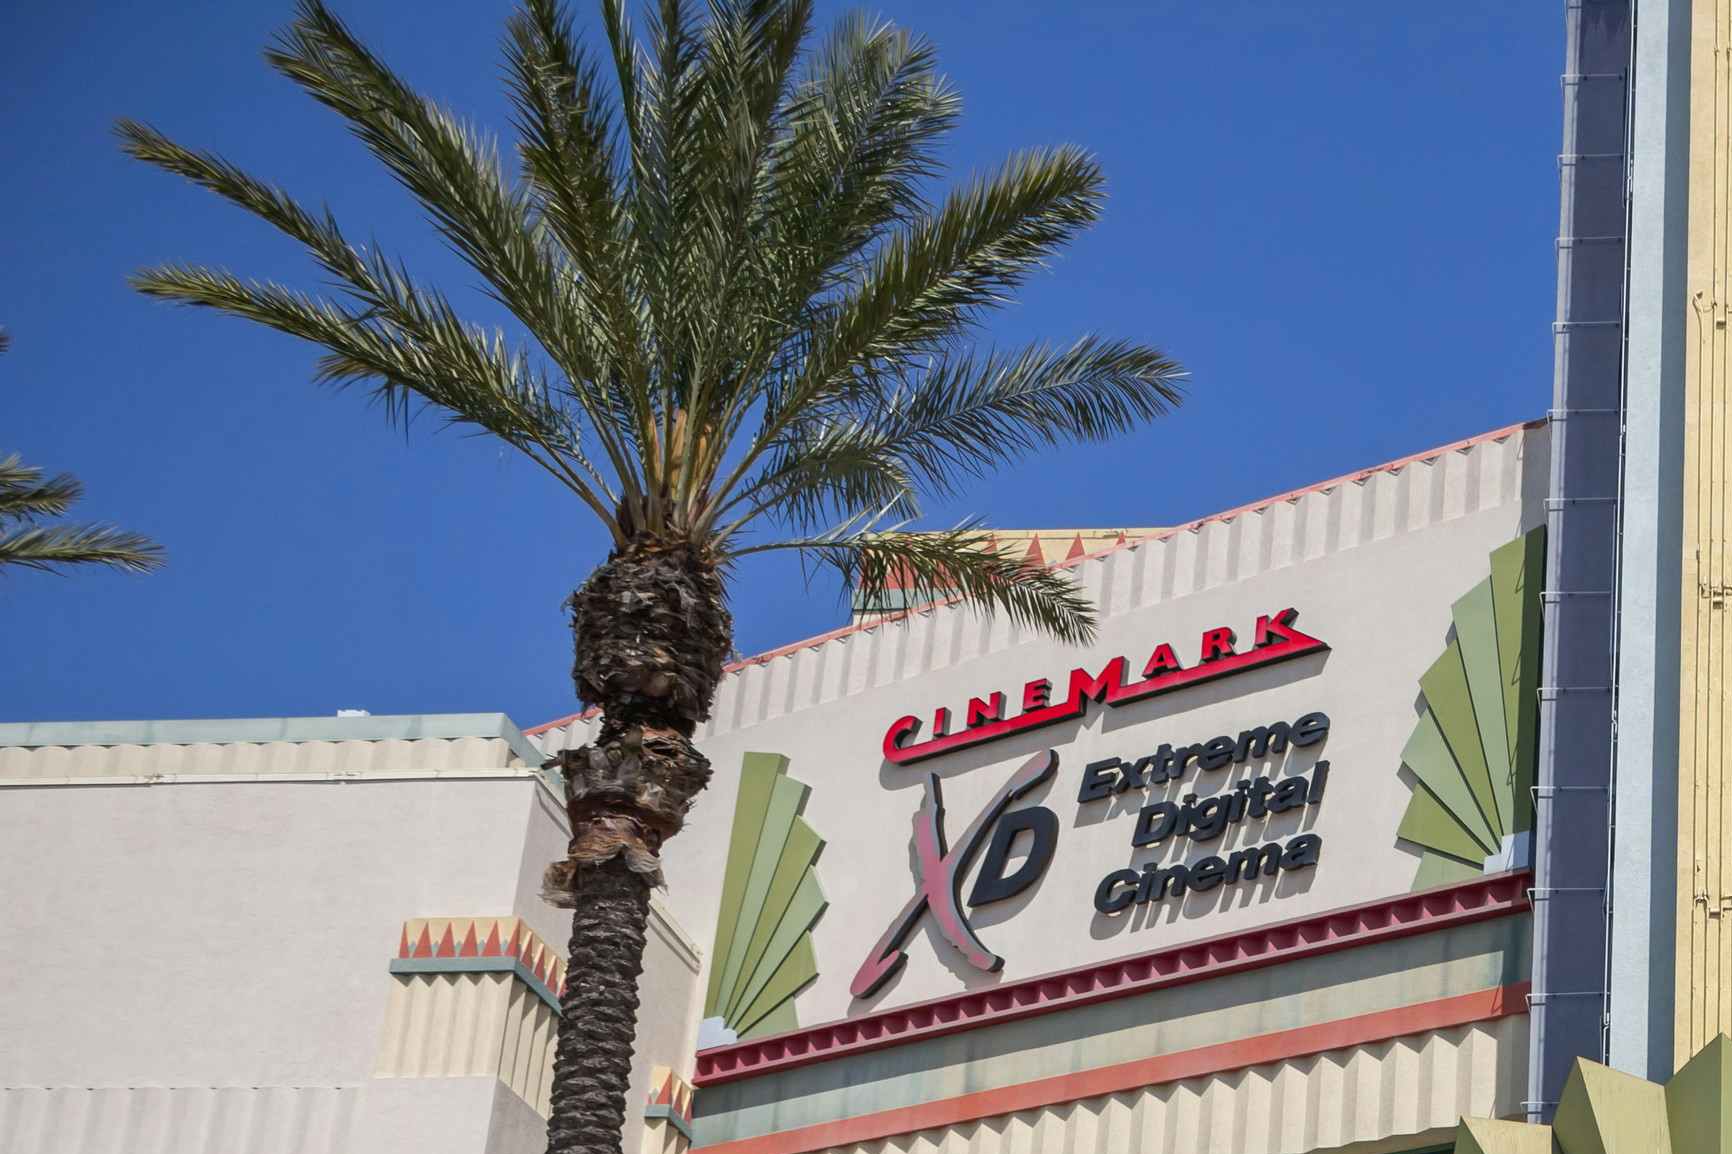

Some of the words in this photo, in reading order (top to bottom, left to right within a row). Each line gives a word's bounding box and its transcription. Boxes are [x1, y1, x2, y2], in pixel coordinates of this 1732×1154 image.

[883, 607, 1330, 765] CINEMARK
[1078, 711, 1330, 803] Extreme
[1132, 761, 1329, 847] Digital
[850, 749, 1058, 999] XD
[1094, 830, 1322, 915] Cinema
